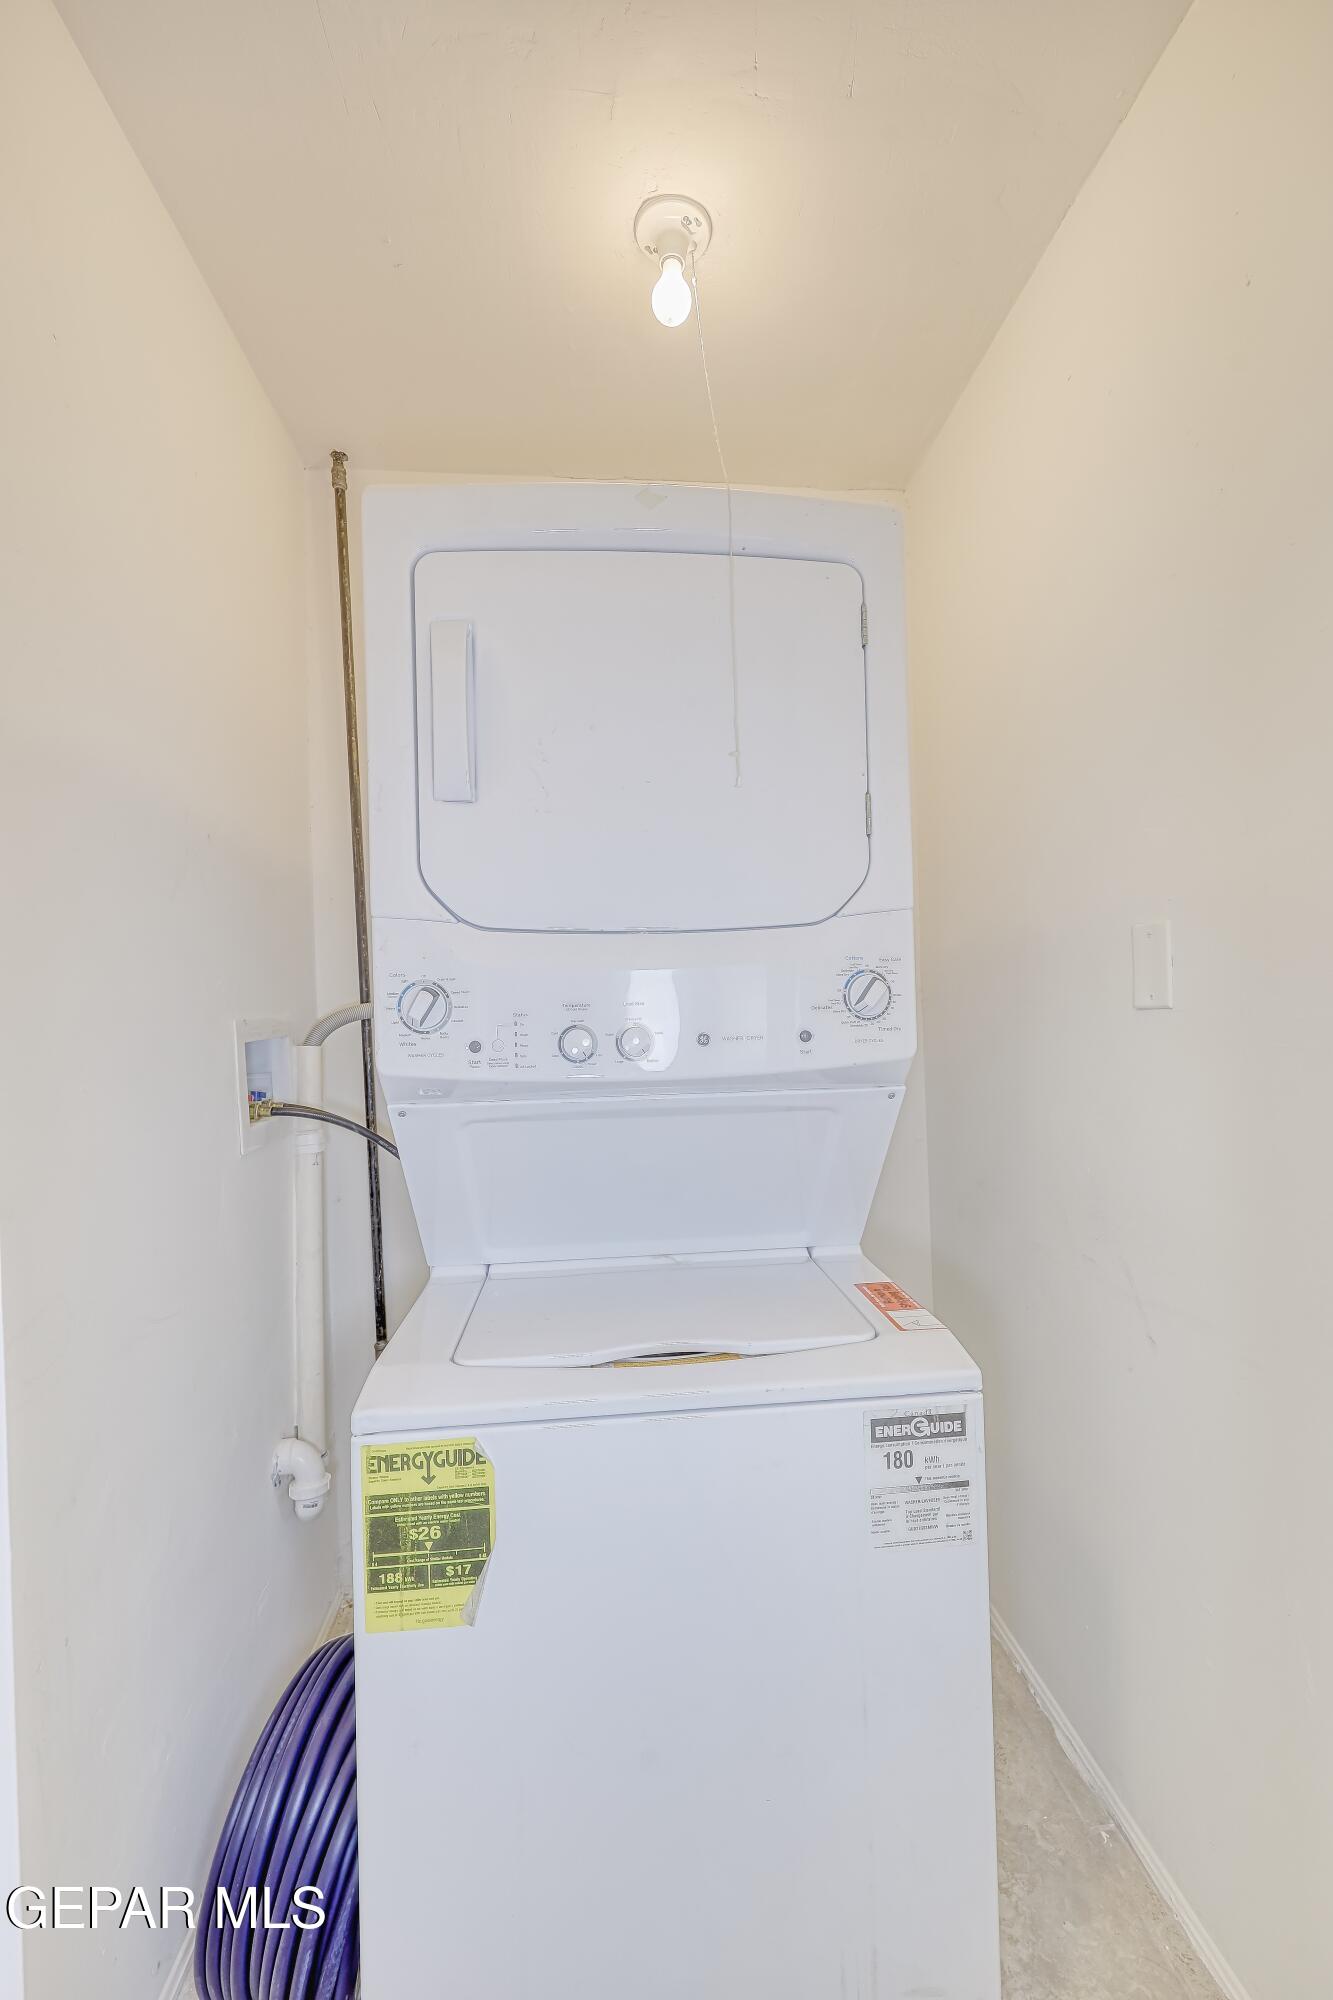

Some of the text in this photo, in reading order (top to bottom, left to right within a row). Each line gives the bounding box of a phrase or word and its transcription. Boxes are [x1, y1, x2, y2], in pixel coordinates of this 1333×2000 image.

[875, 1416, 962, 1438] ENERGUIDE
[883, 1450, 914, 1470] 180
[924, 1456, 940, 1464] kWh
[408, 1526, 442, 1540] $26
[446, 1564, 471, 1577] $17
[379, 1572, 402, 1584] 188
